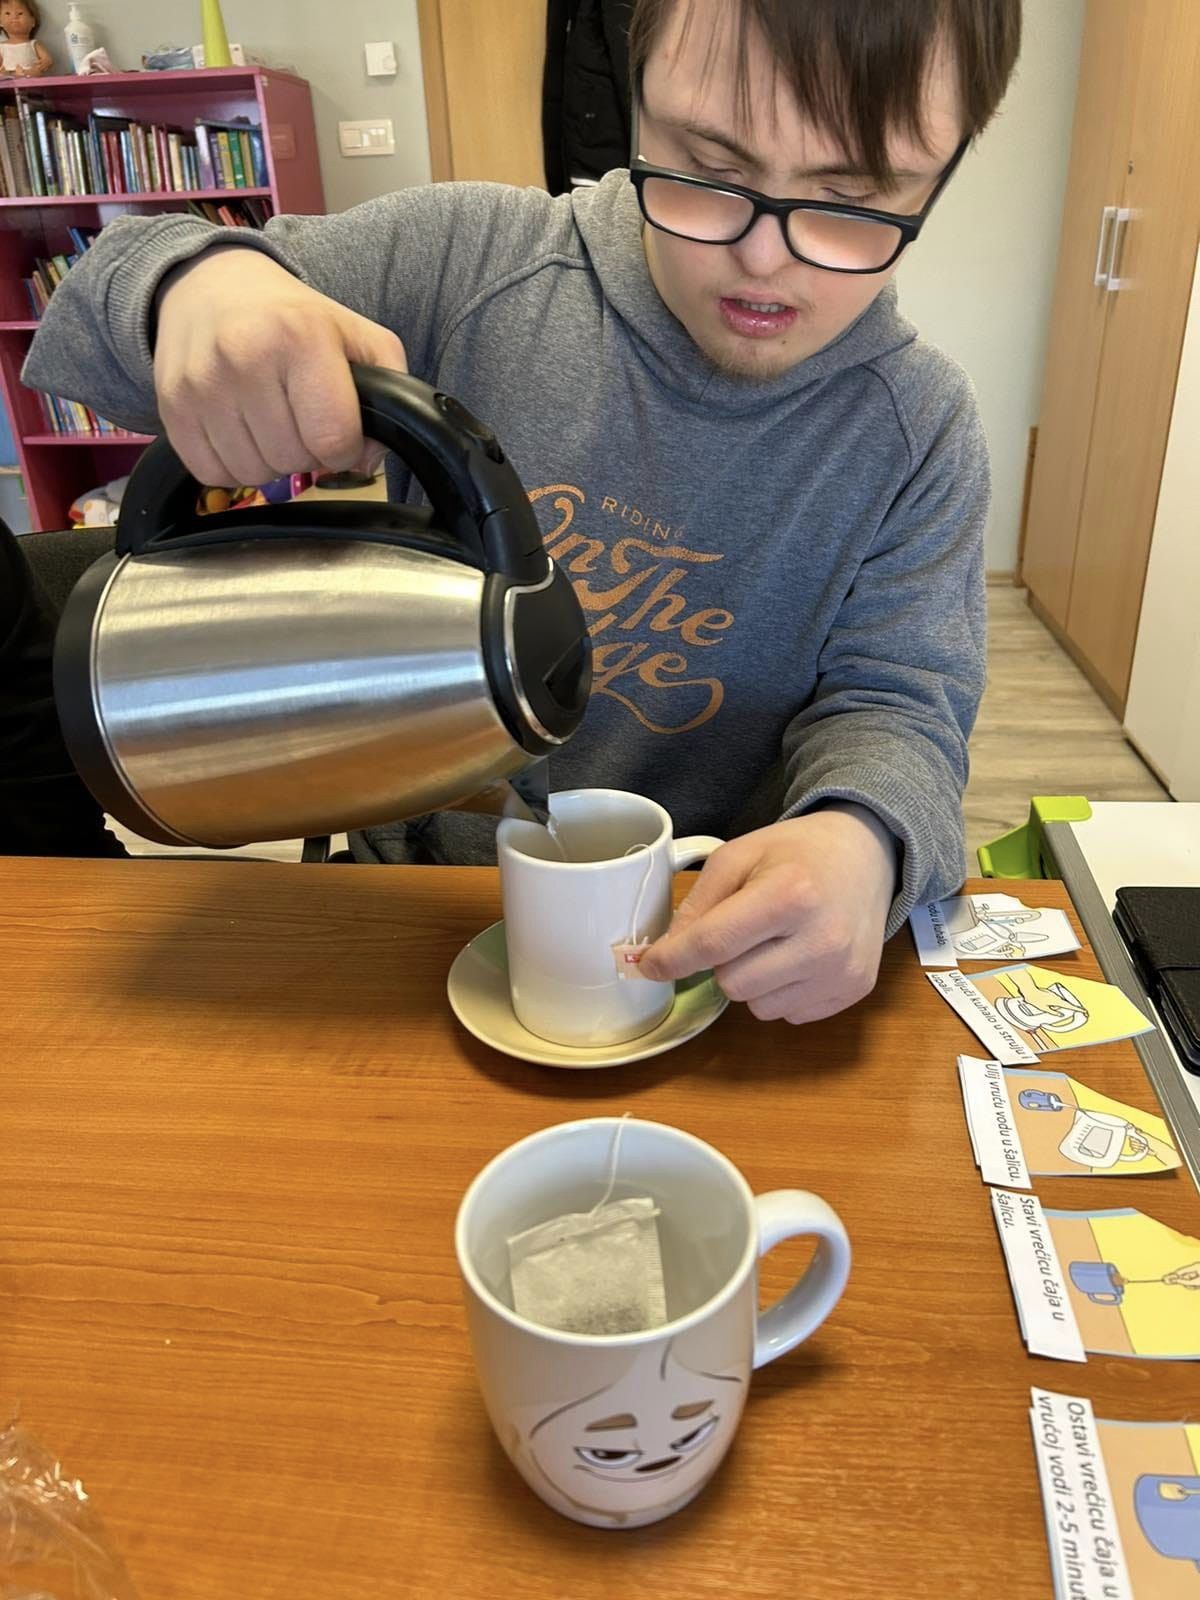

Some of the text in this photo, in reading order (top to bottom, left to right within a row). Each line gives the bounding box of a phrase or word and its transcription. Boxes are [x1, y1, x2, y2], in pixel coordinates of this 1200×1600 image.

[927, 902, 941, 917] odu
[999, 1030, 1028, 1056] struju
[985, 1063, 1022, 1183] Ulij vruću vodu u šalicu.
[995, 1192, 1017, 1230] šalicu.
[1019, 1196, 1042, 1227] Stavi
[1042, 1279, 1064, 1309] čaja
[1051, 1309, 1066, 1322] u
[1037, 1395, 1066, 1451] vrućoj
[1067, 1401, 1095, 1457] Ostavi
[1049, 1453, 1073, 1496] vodi
[1056, 1499, 1080, 1534] 2-5
[1092, 1534, 1120, 1580] čaja
[1101, 1582, 1120, 1599] u
